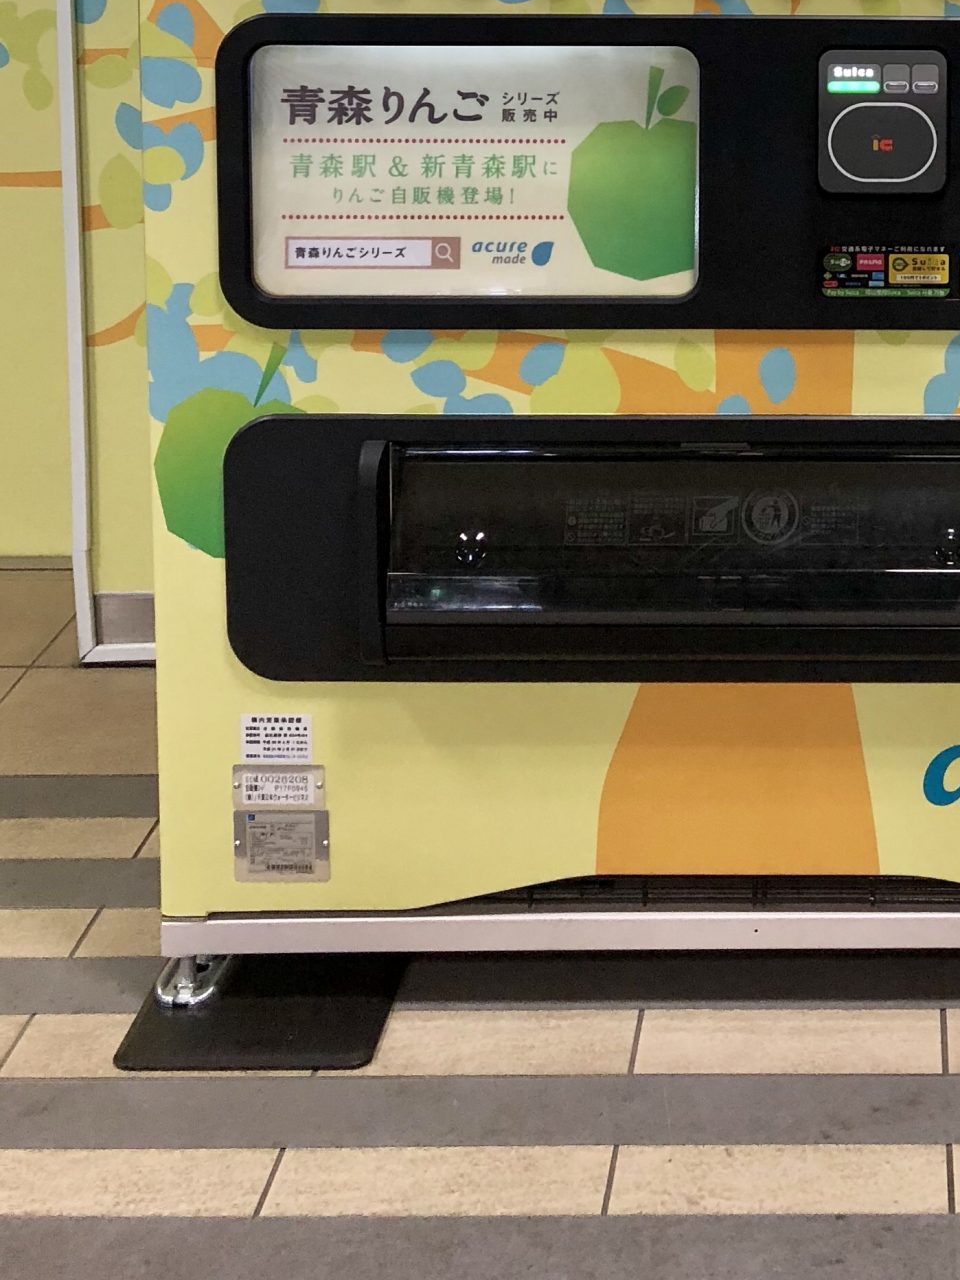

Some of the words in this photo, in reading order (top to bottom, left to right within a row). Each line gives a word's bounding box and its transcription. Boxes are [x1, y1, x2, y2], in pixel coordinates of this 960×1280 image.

[502, 92, 560, 105] シリーズ
[281, 85, 490, 126] 青森りんご
[502, 109, 558, 123] 販売中
[388, 156, 408, 177] &
[295, 246, 406, 259] 青森りんごシリーズ
[472, 241, 527, 253] acure
[492, 255, 526, 265] made
